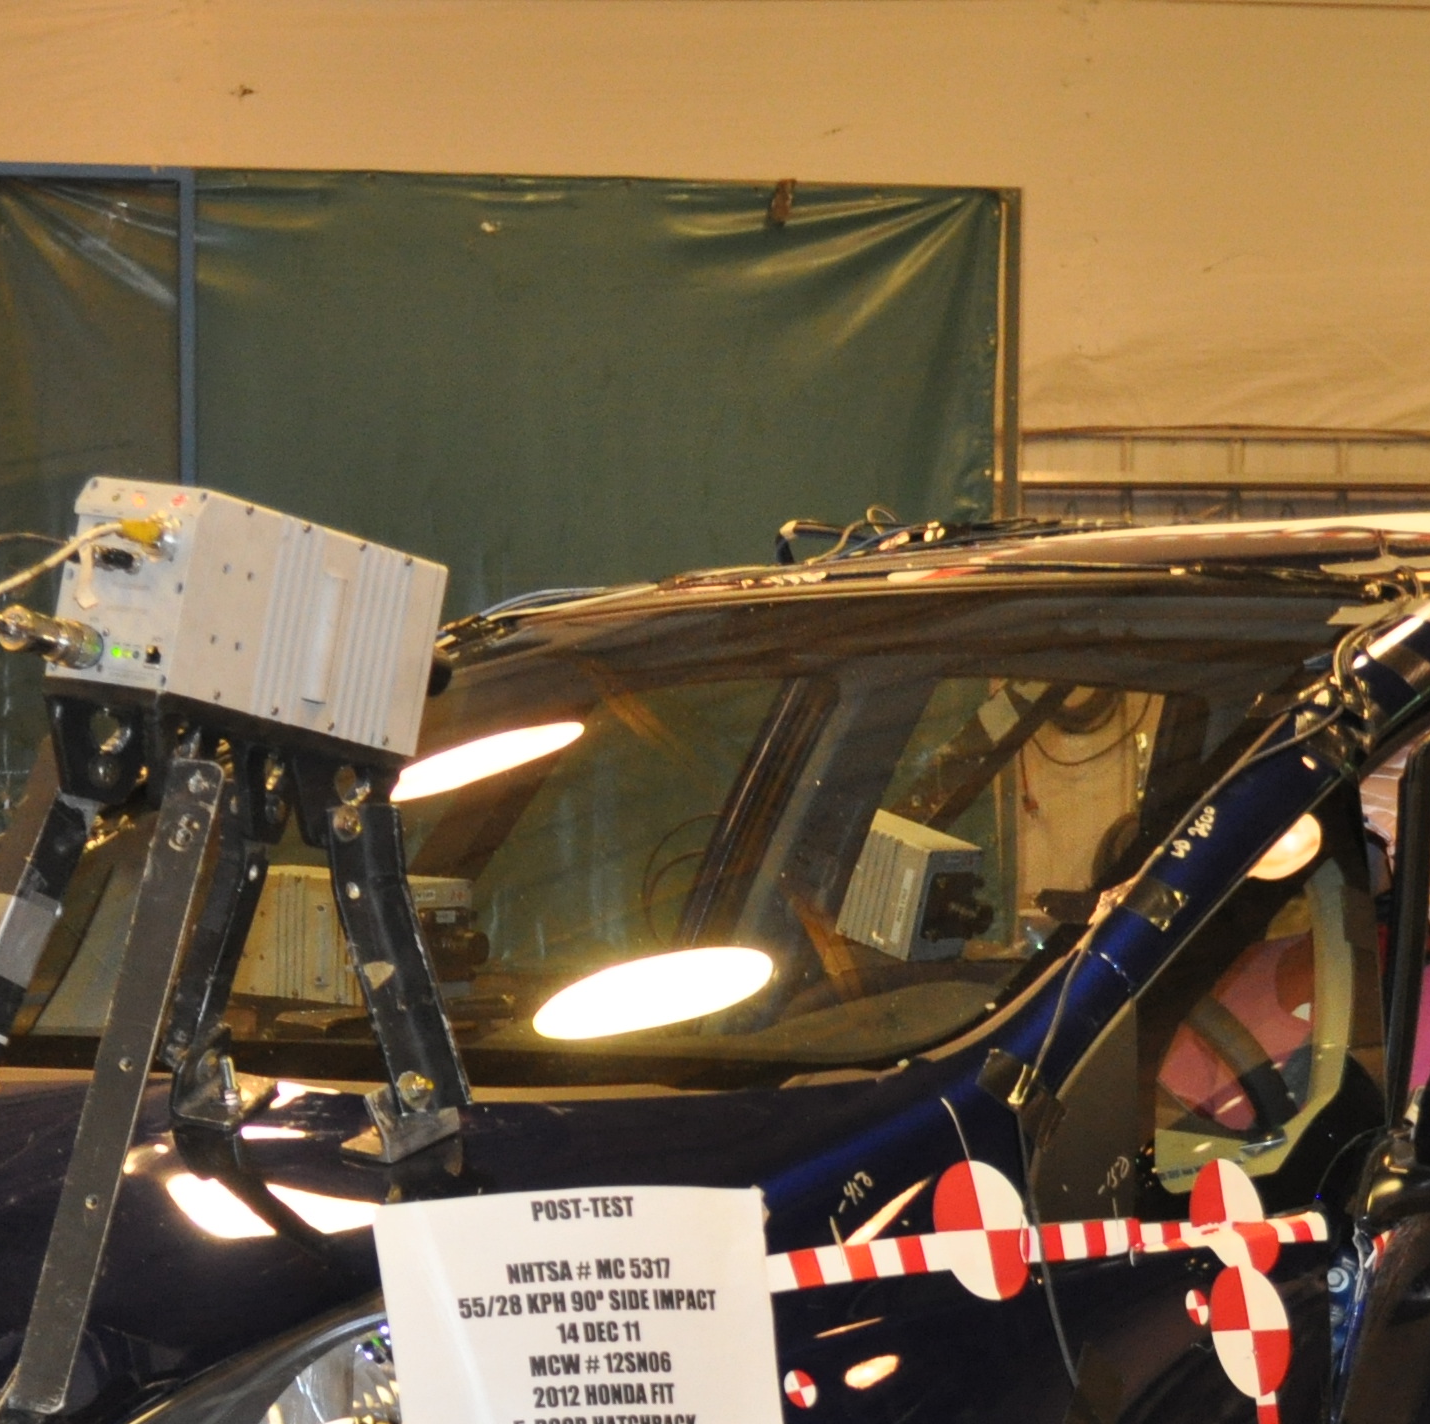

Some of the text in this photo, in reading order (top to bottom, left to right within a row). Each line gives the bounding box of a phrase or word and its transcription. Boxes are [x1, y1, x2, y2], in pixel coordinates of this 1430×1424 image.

[531, 1196, 634, 1221] POST-TEST
[506, 1257, 670, 1285] NHTSA # MC 5317
[458, 1294, 523, 1319] 55/28
[527, 1292, 567, 1315] KPH
[609, 1289, 651, 1311] SIDE
[653, 1288, 716, 1311] IMPACT
[556, 1320, 642, 1344] 14 DEC 11
[529, 1353, 581, 1377] MCW
[584, 1354, 601, 1375] #
[532, 1382, 675, 1409] 2012 HONDA FIT
